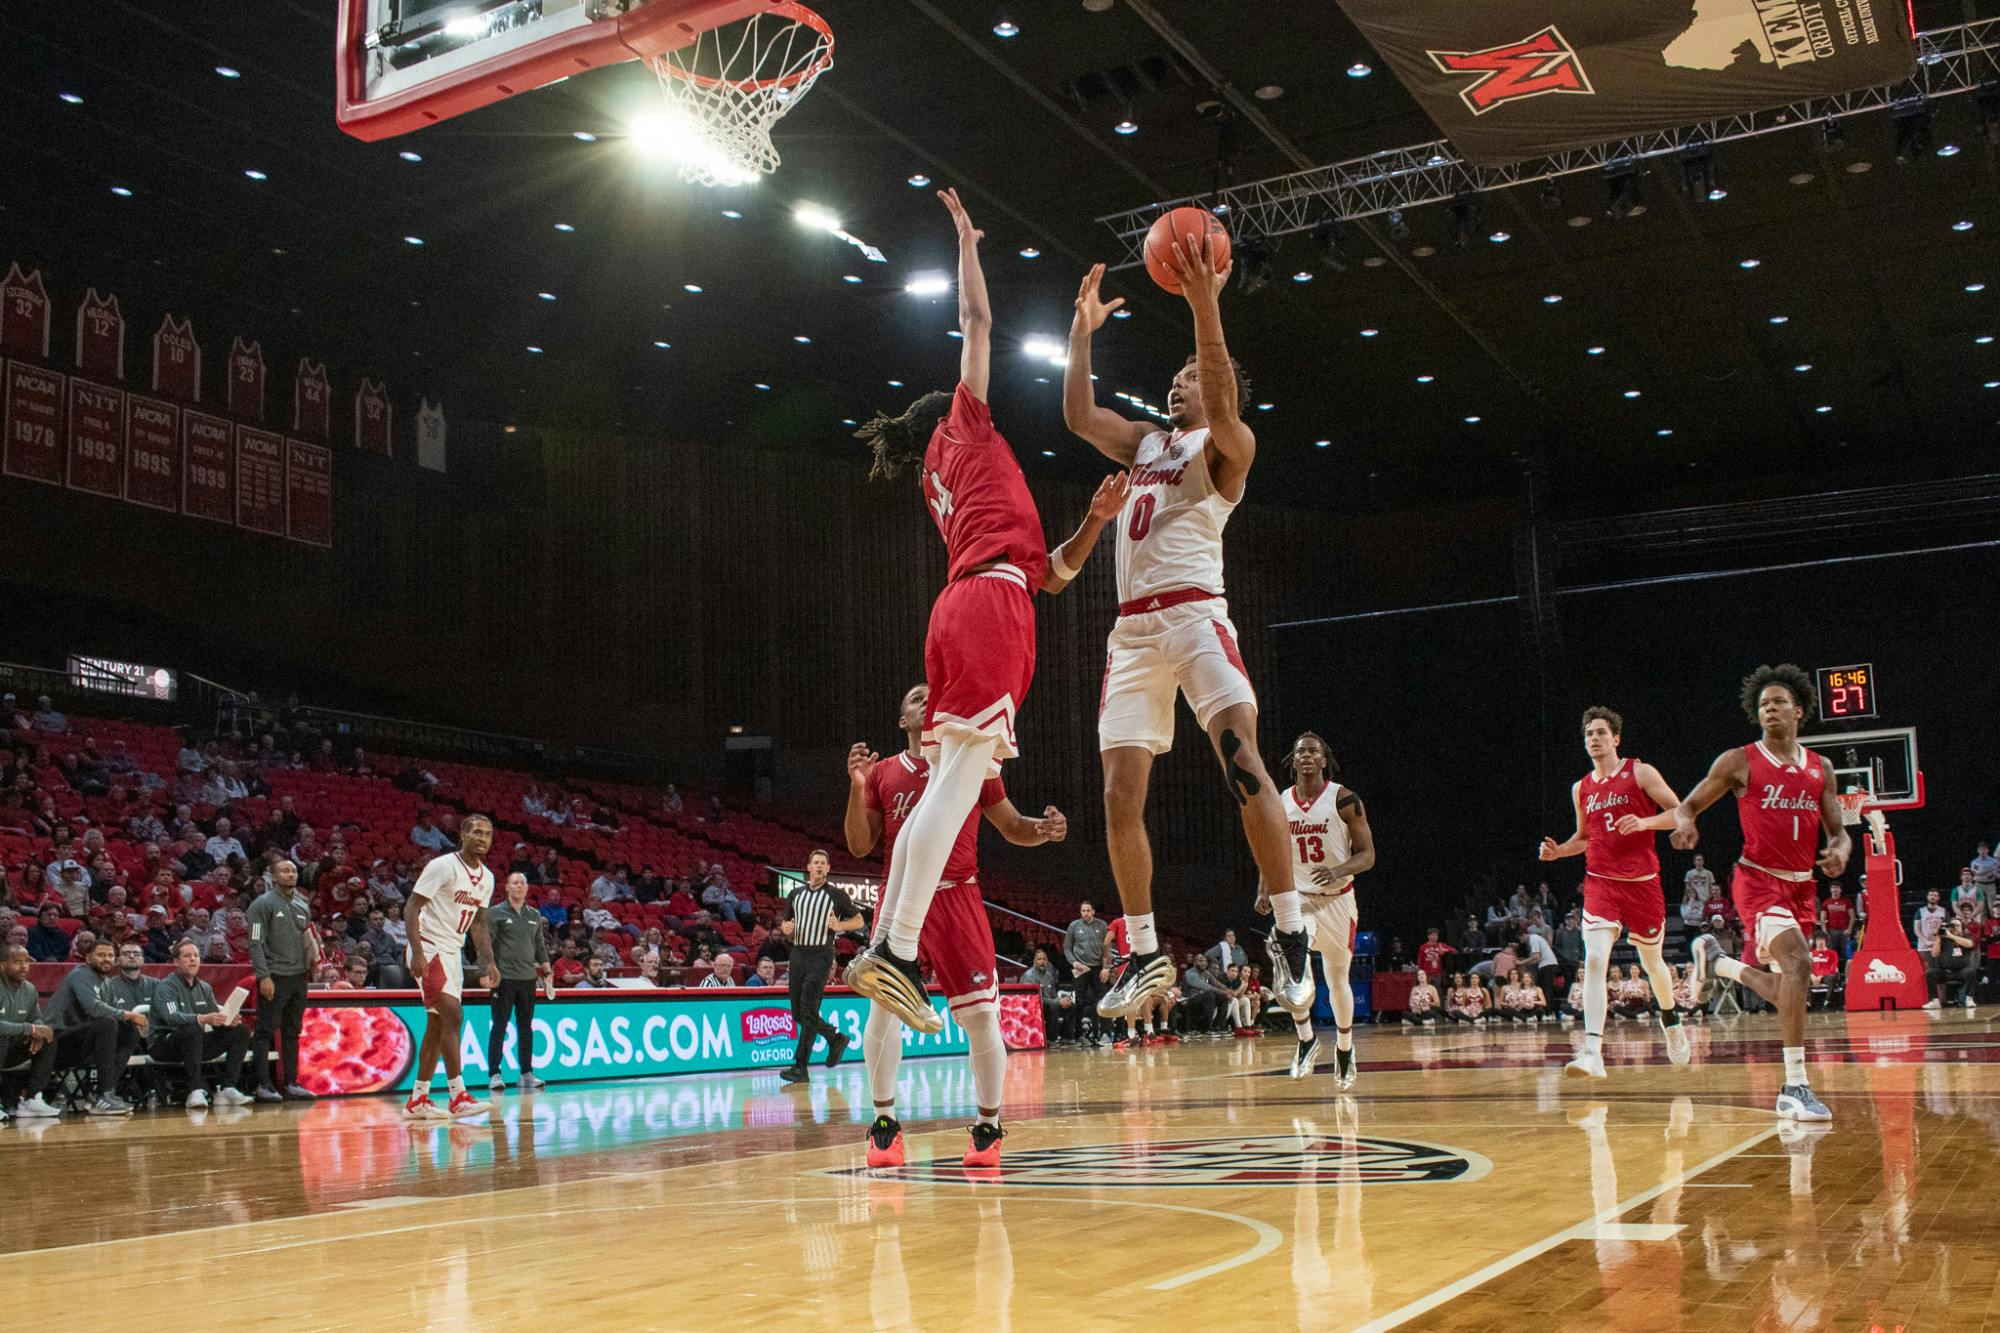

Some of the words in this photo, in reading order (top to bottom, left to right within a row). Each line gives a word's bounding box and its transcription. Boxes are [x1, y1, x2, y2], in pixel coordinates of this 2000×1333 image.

[1801, 2, 1835, 59] CREDIT
[1839, 8, 1860, 46] OFFICIAL
[1861, 18, 1880, 46] MIAMI
[16, 300, 33, 319] 32
[94, 318, 110, 338] 12
[170, 347, 184, 363] 10
[15, 374, 56, 396] NCAA
[240, 366, 254, 384] 23
[78, 391, 119, 413] NIT
[135, 406, 171, 428] NCAA
[191, 423, 227, 442] NCAA
[78, 436, 116, 463] 1993
[244, 437, 279, 457] NCAA
[134, 449, 171, 477] 1995
[293, 451, 327, 469] NIT
[191, 466, 227, 490] 1999
[1130, 460, 1190, 487] Miami
[1128, 493, 1157, 541] 0
[133, 664, 146, 678] 21
[1829, 670, 1867, 687] 16:46
[1832, 686, 1864, 714] 27
[1586, 791, 1629, 815] Huskies
[1289, 818, 1330, 835] Miami
[1603, 812, 1616, 832] 2
[1793, 815, 1799, 841] 1
[1296, 835, 1325, 864] 13
[456, 909, 474, 934] 11
[434, 1013, 733, 1074] AROSAS.COM
[751, 1048, 794, 1063] OXFORD
